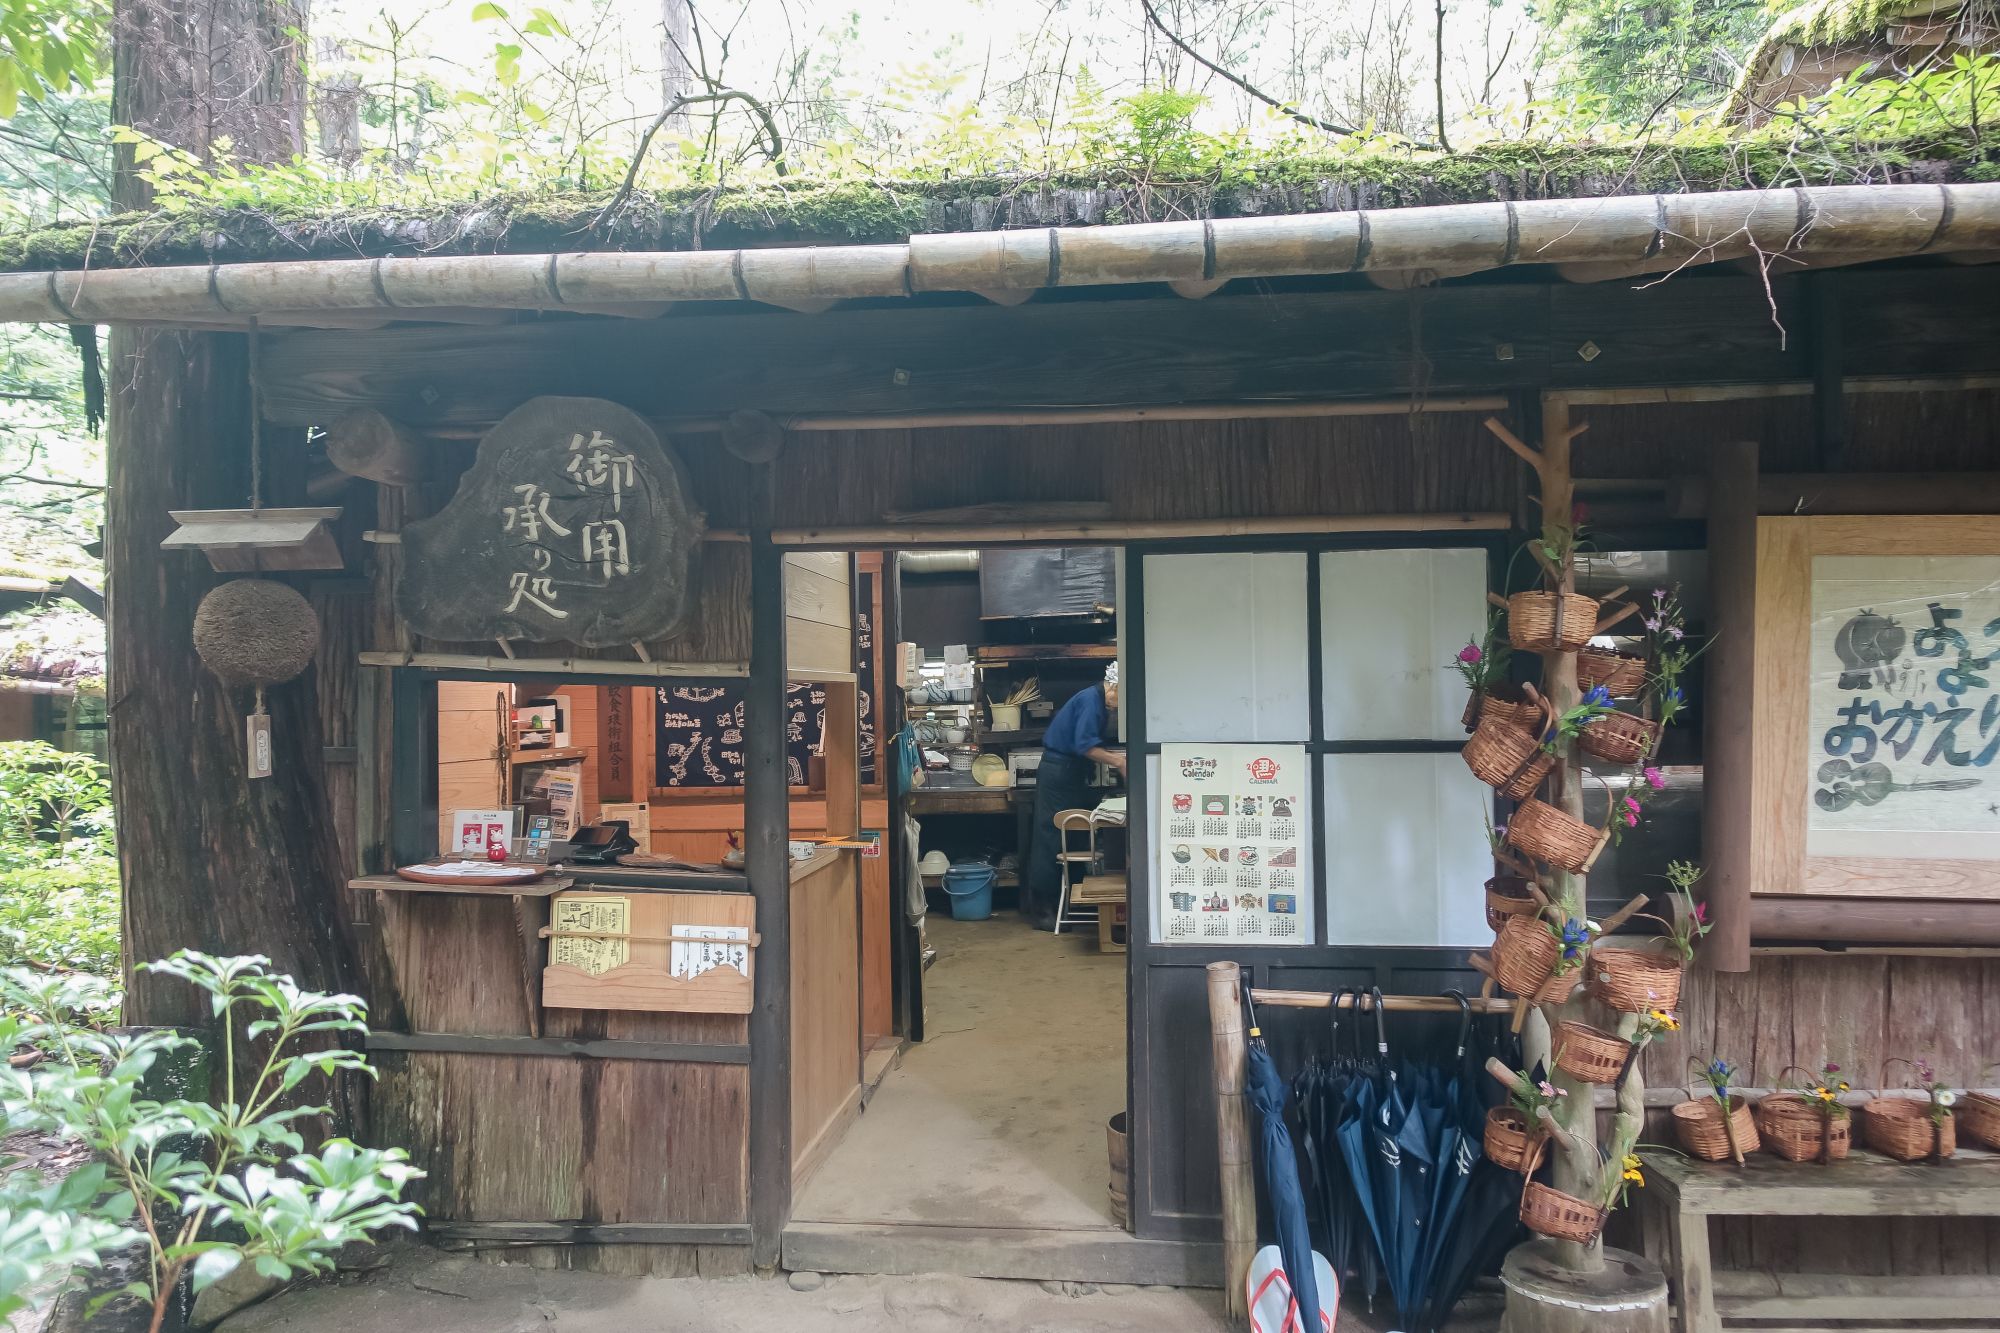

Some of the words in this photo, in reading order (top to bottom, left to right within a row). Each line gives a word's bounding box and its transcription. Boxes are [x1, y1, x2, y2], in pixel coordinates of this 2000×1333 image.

[566, 430, 635, 579] 御用
[502, 483, 572, 619] 承り処
[1180, 759, 1217, 769] 日本の手仕事
[1182, 768, 1215, 778] Calendar
